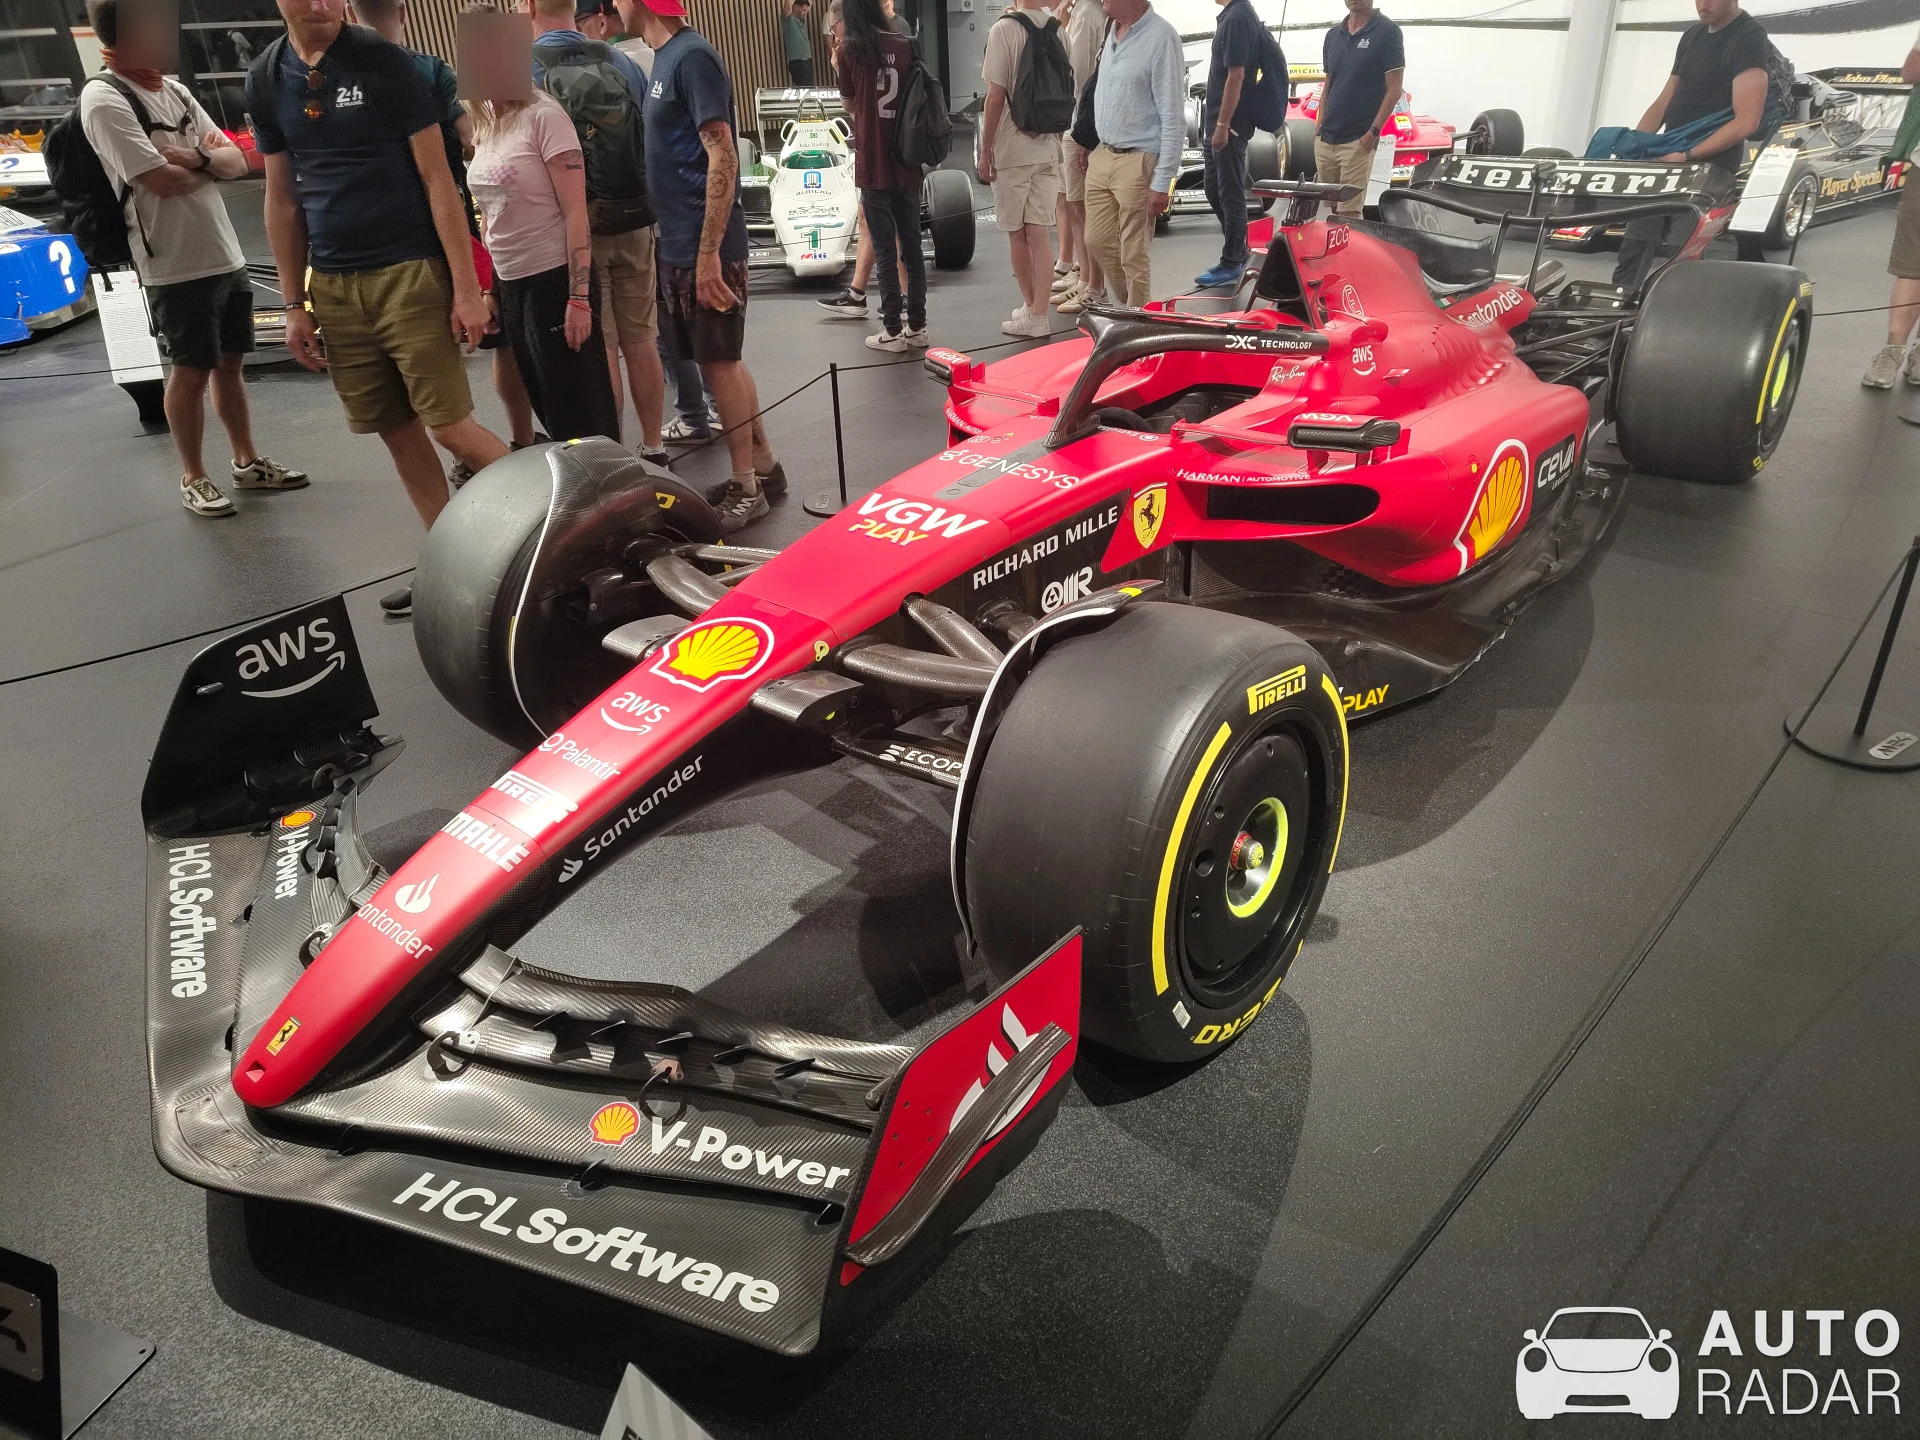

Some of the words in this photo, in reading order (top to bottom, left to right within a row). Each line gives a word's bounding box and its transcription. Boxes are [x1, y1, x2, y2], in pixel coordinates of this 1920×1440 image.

[336, 85, 363, 103] 24h
[780, 88, 810, 100] FLY
[1839, 73, 1873, 83] John
[1451, 159, 1688, 195] Ferrari
[1819, 177, 1851, 200] Player
[1850, 165, 1884, 194] Special
[801, 229, 822, 250] 1
[1328, 225, 1350, 249] ZCG
[49, 240, 76, 294] ?
[1225, 335, 1258, 350] DXC
[1260, 339, 1313, 350] TECHNOLOGY
[1352, 345, 1374, 364] aws
[1270, 365, 1306, 383] Ray-Ban
[958, 453, 1080, 490] GENESYS
[1176, 468, 1241, 483] HARMAN
[1246, 474, 1312, 483] AUTOMOTIVE
[847, 518, 930, 547] PLAY
[857, 492, 990, 539] VGW
[973, 534, 1059, 591] RICHARD
[1065, 505, 1118, 546] MILLE
[235, 617, 337, 680] aws
[1247, 664, 1307, 715] PIRELLI
[1344, 683, 1390, 713] PLAY
[611, 691, 671, 724] aws
[553, 745, 622, 781] Palantir
[903, 750, 964, 773] ECOP
[583, 755, 703, 861] Santander
[440, 811, 531, 873] MAHLE
[168, 842, 217, 998] HCLSoftware
[356, 902, 434, 960] antander
[650, 1116, 850, 1189] V-Power
[387, 1171, 781, 1314] HCLSoftware
